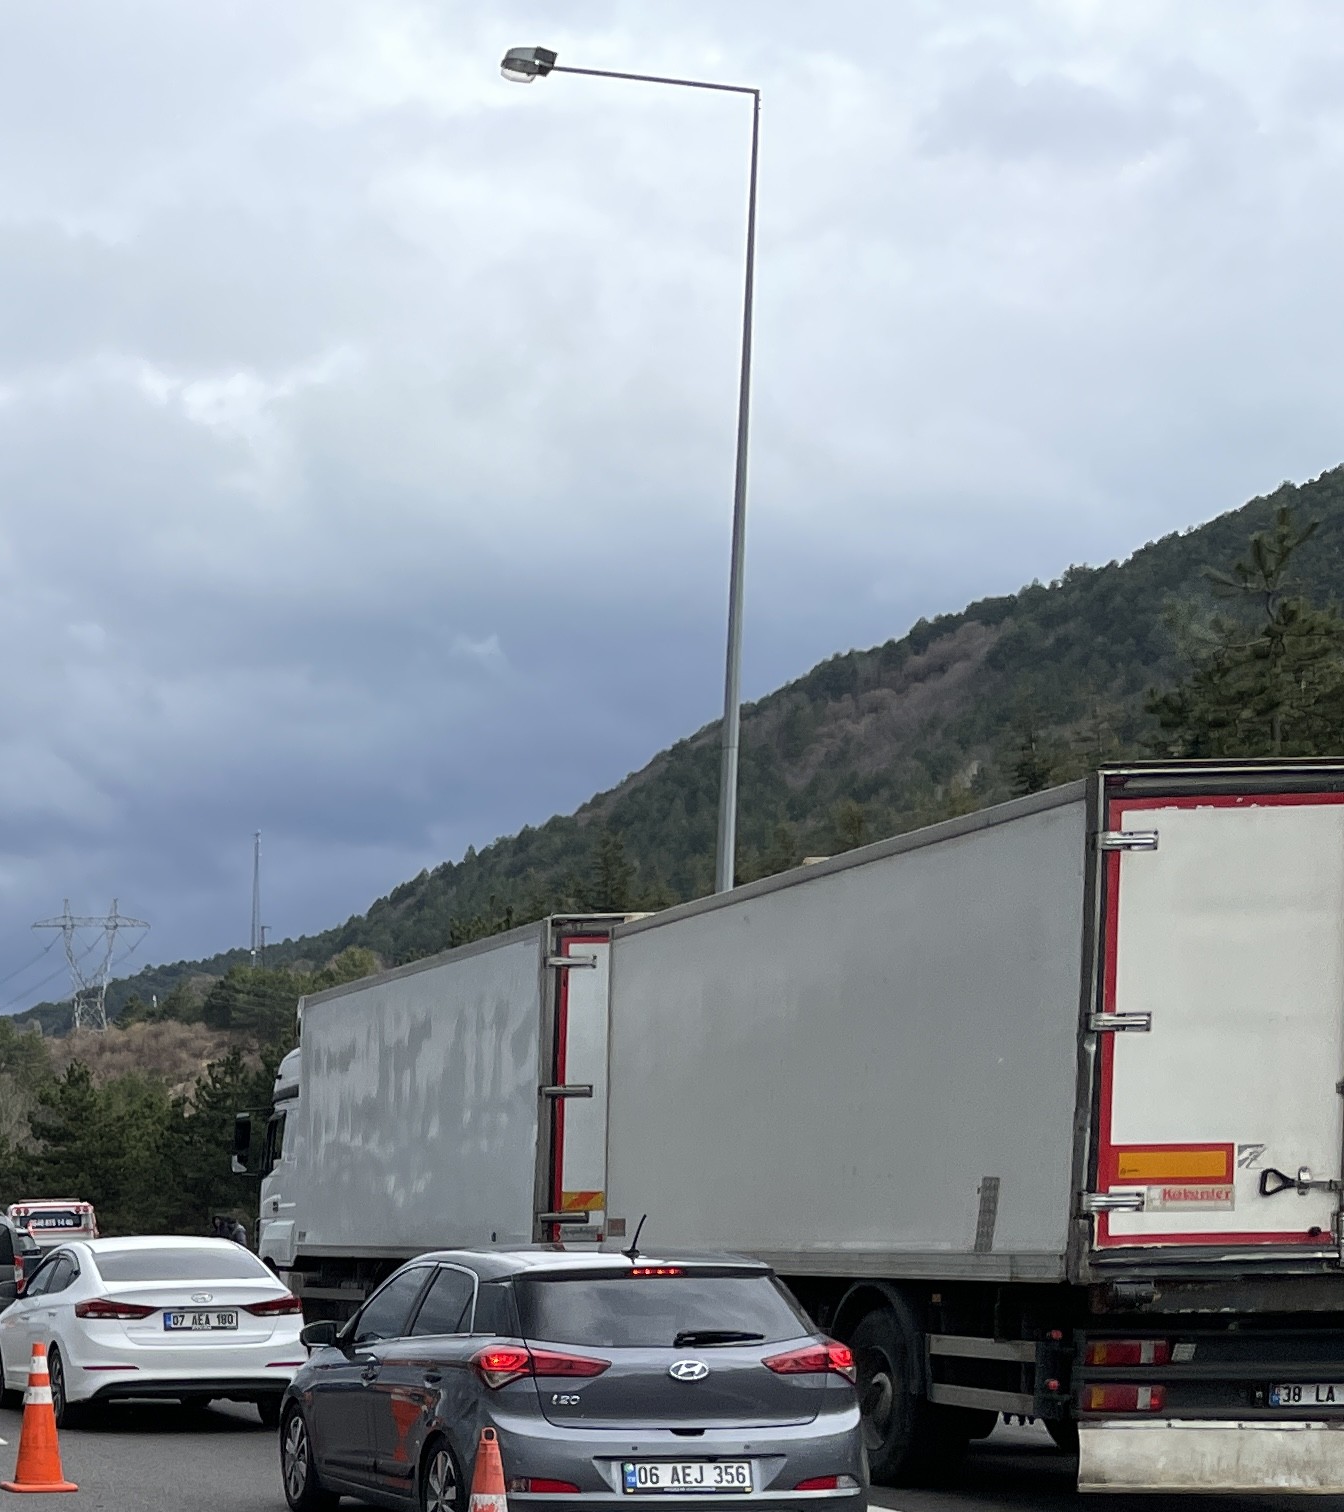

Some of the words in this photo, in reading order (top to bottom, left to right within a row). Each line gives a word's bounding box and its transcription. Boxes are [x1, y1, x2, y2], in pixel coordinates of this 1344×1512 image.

[172, 1314, 186, 1326] 07
[216, 1313, 234, 1325] 180
[1282, 1385, 1302, 1402] 38
[638, 1465, 660, 1485] 06
[670, 1465, 704, 1485] AEJ
[714, 1464, 747, 1485] 356
